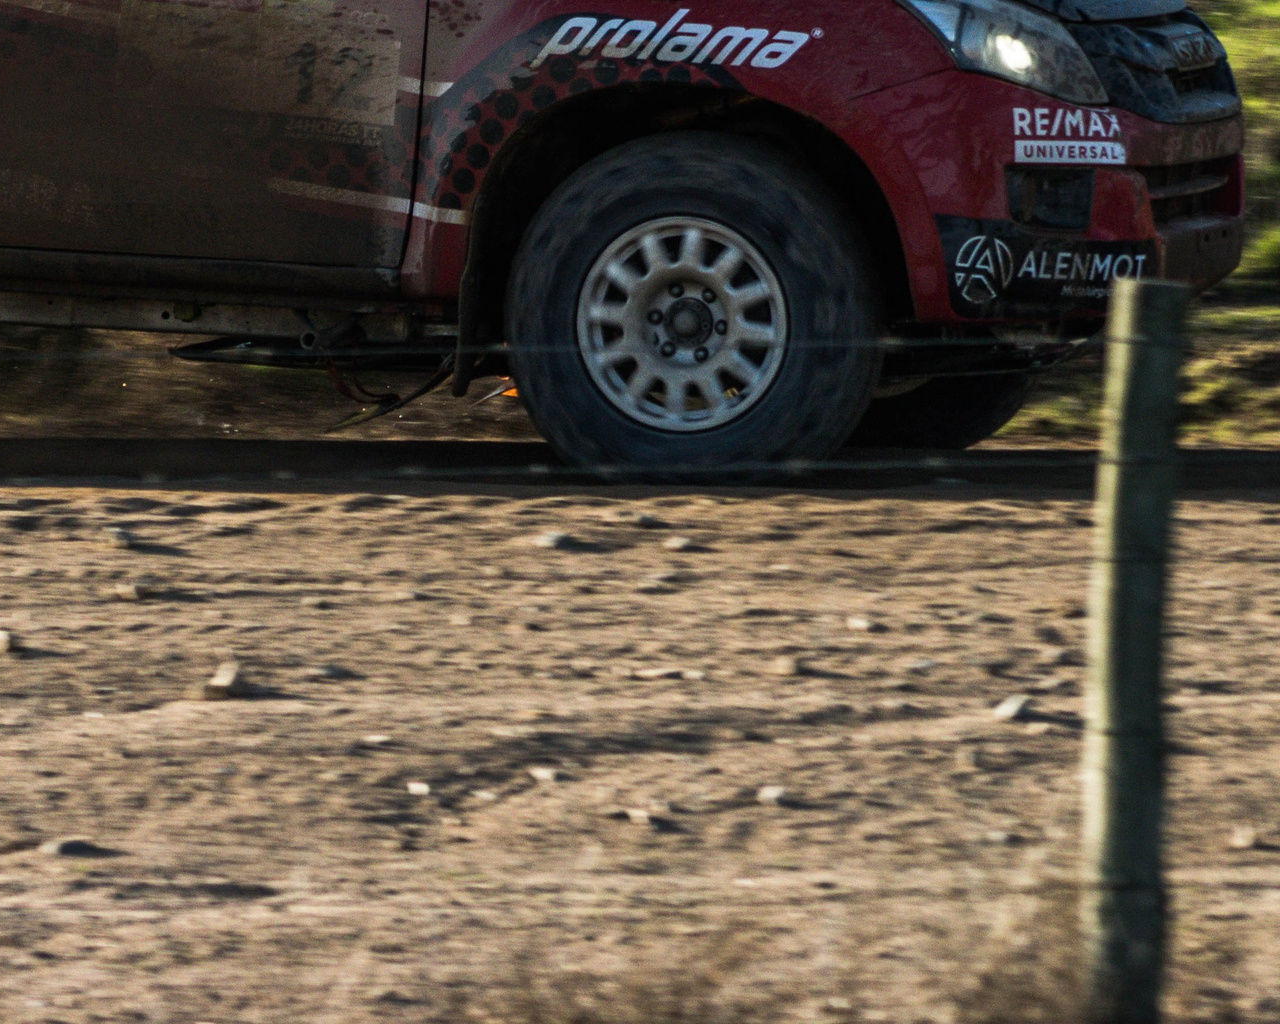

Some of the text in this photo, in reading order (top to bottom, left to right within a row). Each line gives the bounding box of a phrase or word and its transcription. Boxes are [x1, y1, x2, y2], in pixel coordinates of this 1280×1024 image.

[528, 8, 811, 69] prolama
[1012, 107, 1120, 138] RE/MAX
[1023, 145, 1119, 160] UNIVERSAL
[1017, 252, 1148, 282] ALENMOT
